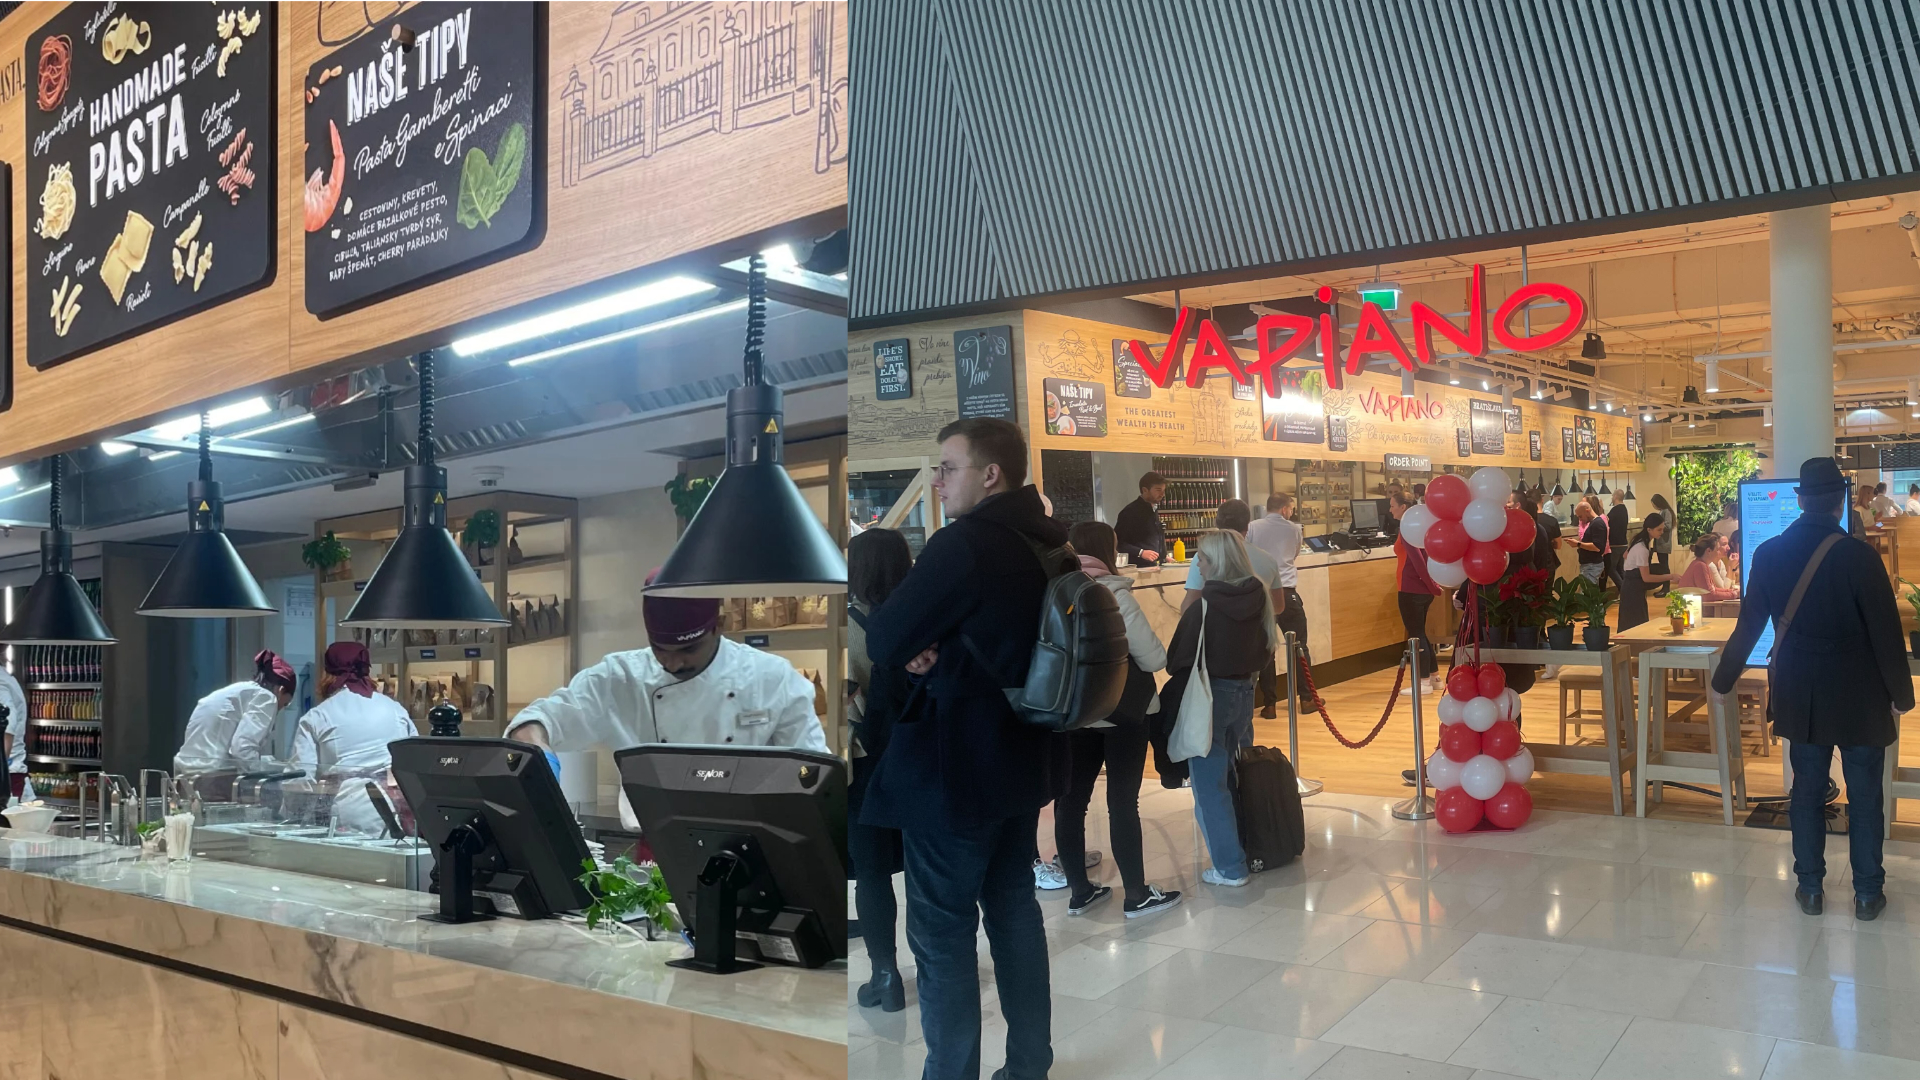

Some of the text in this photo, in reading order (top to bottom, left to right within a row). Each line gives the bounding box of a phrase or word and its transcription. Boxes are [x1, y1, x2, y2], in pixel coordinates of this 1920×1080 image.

[191, 43, 217, 79] Fusilli
[347, 8, 471, 125] NAŠE TIPY
[90, 43, 187, 137] HANDMADE
[207, 116, 233, 152] Fusilli
[354, 65, 481, 180] Pasta Gamberetti
[435, 82, 513, 165] e Spinaci
[90, 94, 188, 207] PASTA
[163, 177, 210, 228] Campanelle
[347, 194, 448, 243] DOMÁCE BAZALKOVÉ PESTO,
[359, 180, 438, 221] CESTOVINY, KREVETY,
[360, 229, 398, 253] TALIANSKY
[400, 216, 424, 237] TVRDÝ
[43, 242, 73, 276] Linguine
[75, 256, 96, 277] Penne
[329, 227, 449, 282] BABY ŠPENÁT, CHERRY PARADAJKY
[126, 281, 151, 312] Ravioli
[1130, 263, 1588, 399] VAPIANO
[878, 346, 903, 356] LIFE'S
[880, 362, 904, 376] EAT
[881, 383, 906, 393] FIRST.
[1060, 383, 1093, 399] NAŠE TIPY
[1359, 386, 1444, 422] VAPIANO
[1116, 418, 1185, 431] WEALTH IS HEALTH
[1125, 407, 1176, 418] THE GREATEST
[1389, 456, 1429, 467] ORDER POINT
[695, 769, 725, 780] SENOR
